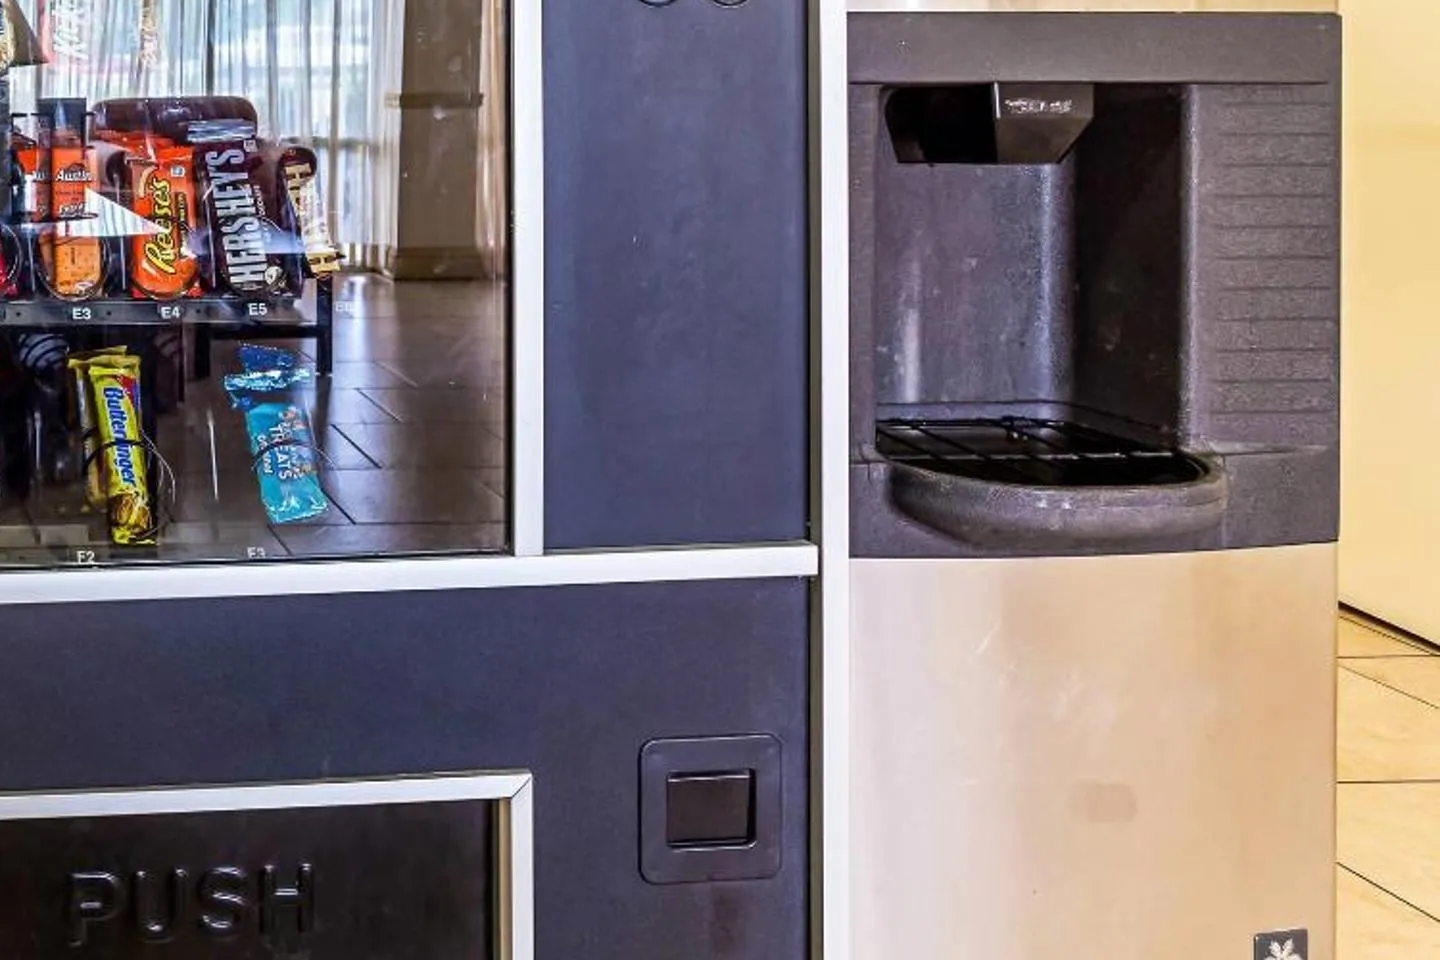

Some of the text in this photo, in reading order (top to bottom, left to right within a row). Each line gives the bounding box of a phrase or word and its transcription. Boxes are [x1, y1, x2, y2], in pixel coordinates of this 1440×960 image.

[205, 148, 268, 283] HERSHEY'S
[72, 307, 92, 320] E3
[160, 306, 180, 319] E4
[249, 302, 268, 315] E5
[103, 386, 136, 488] Butteringer
[76, 551, 95, 564] F2
[68, 863, 313, 947] PUSH
